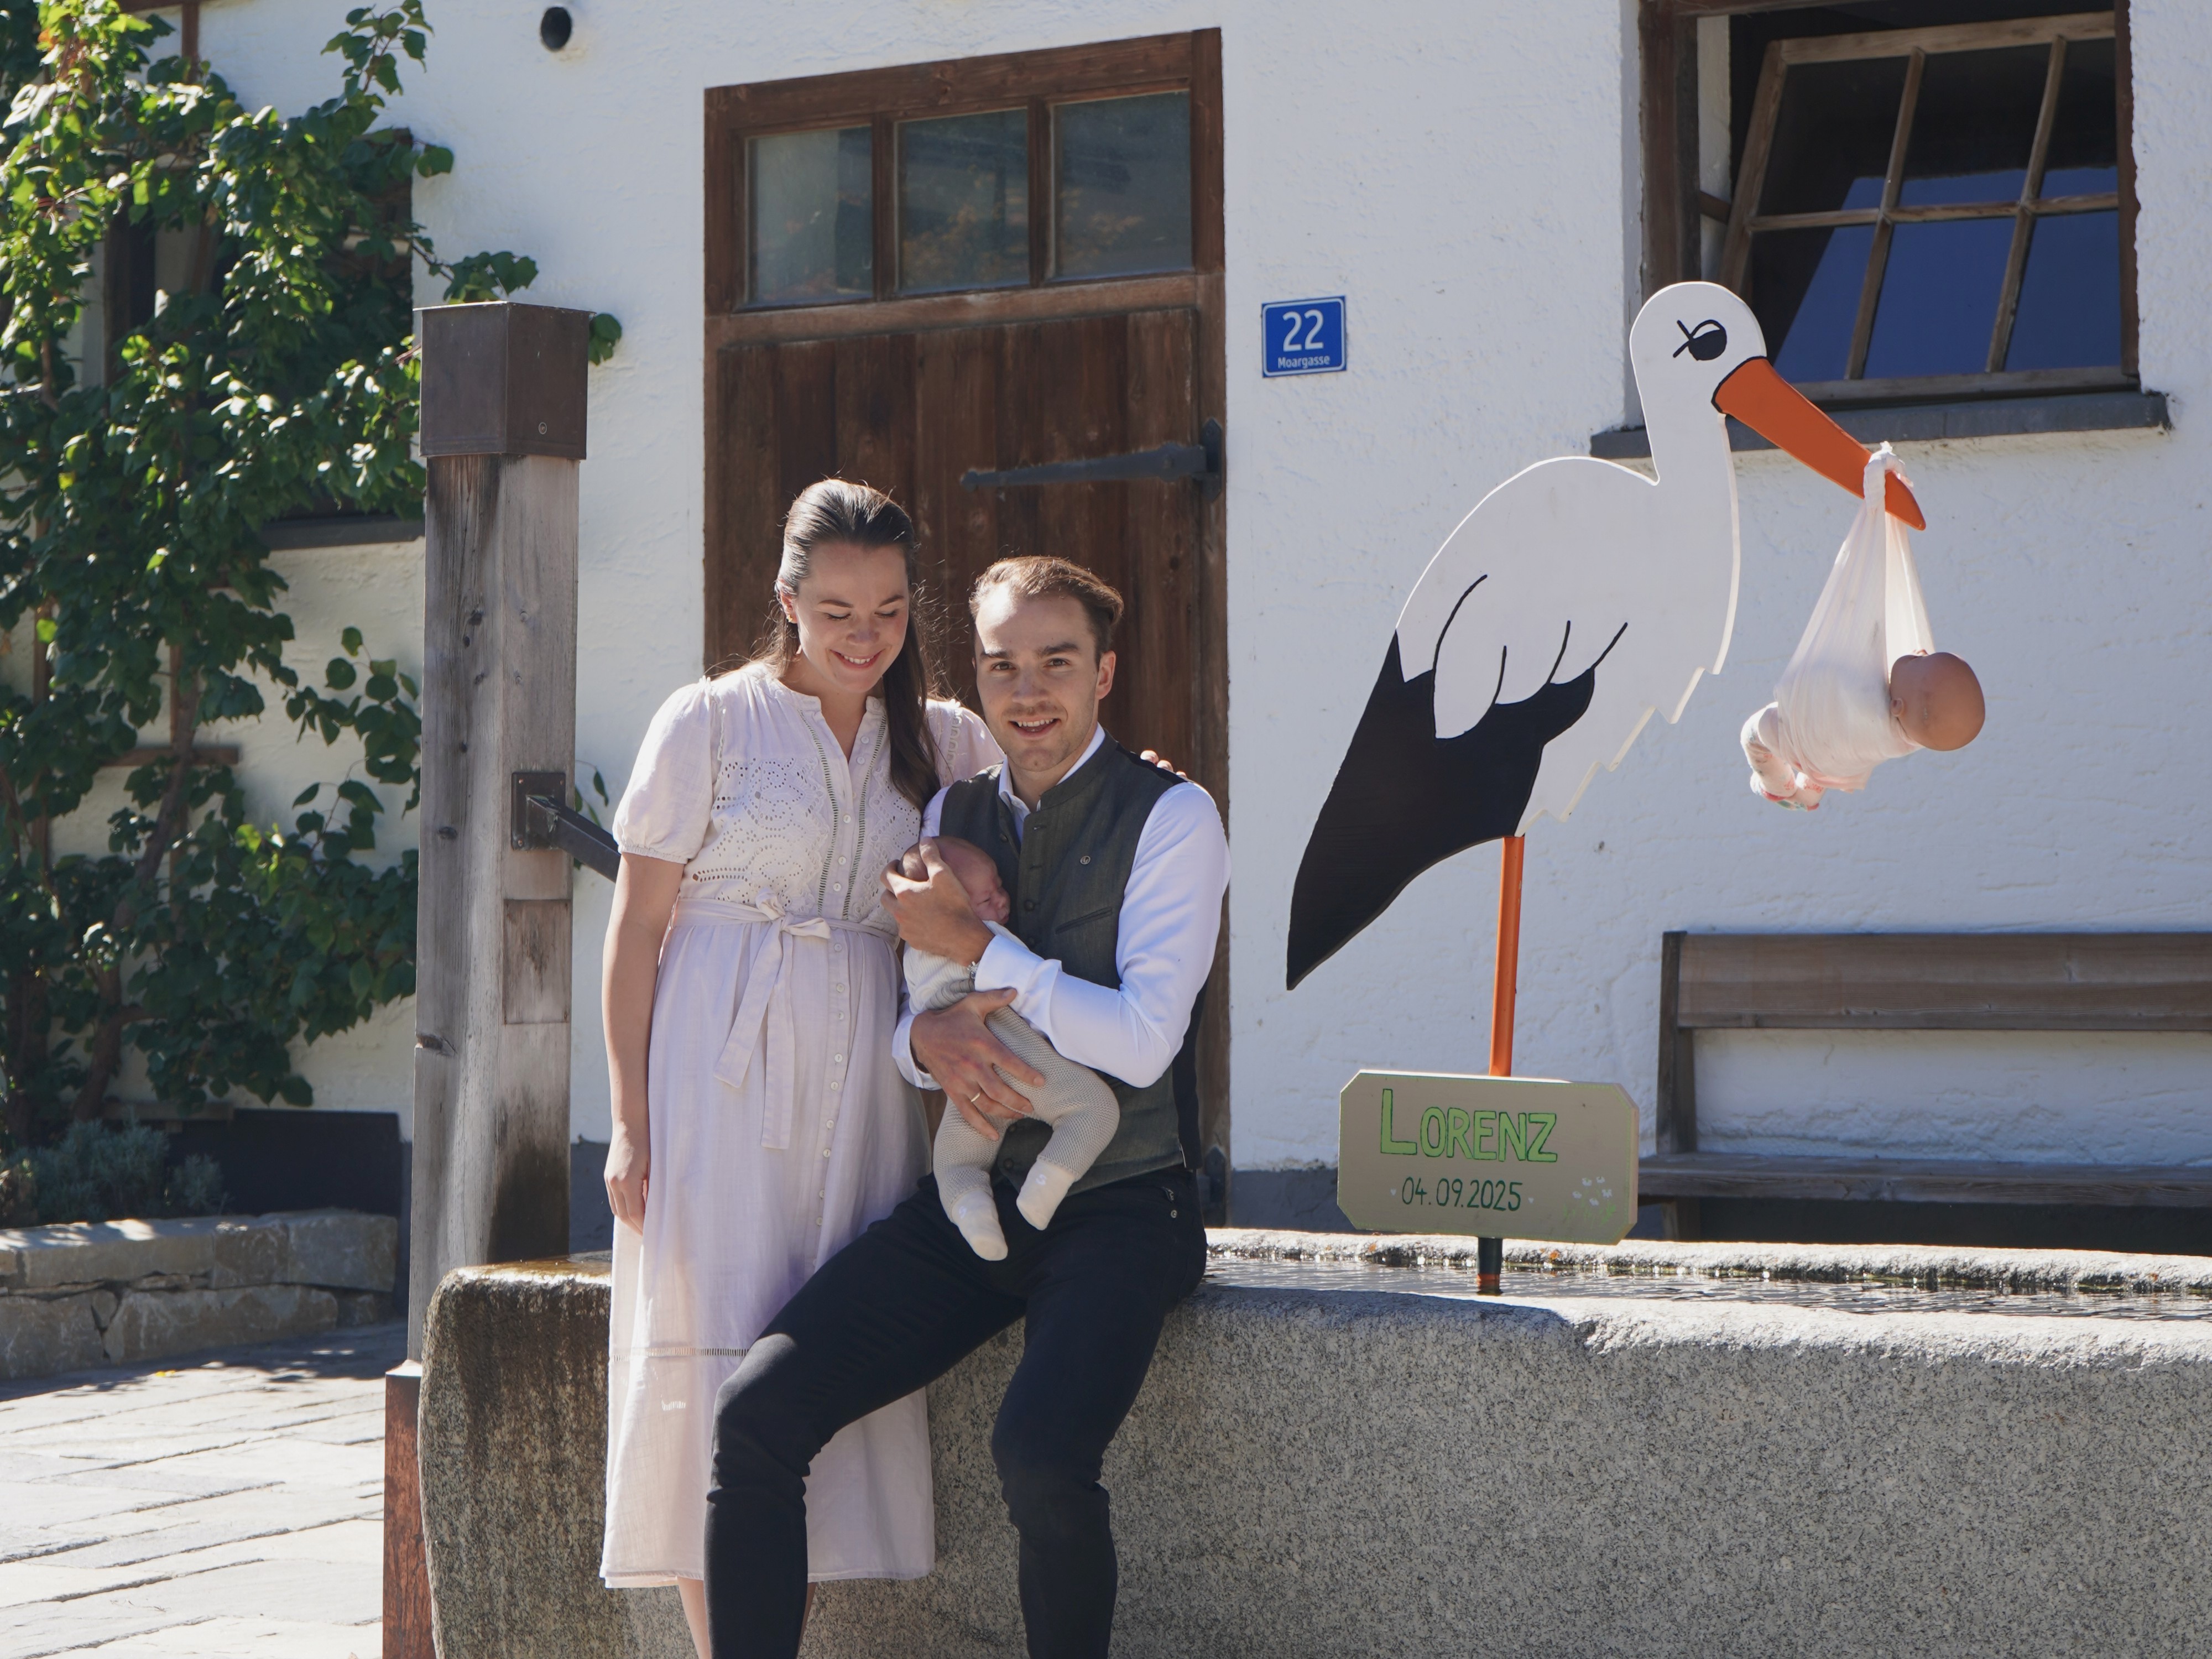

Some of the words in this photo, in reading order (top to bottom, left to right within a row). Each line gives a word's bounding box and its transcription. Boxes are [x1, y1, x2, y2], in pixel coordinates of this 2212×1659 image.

[1282, 310, 1324, 352] 22
[1278, 356, 1331, 369] Moargasse
[1380, 1088, 1558, 1162] LORENZ
[1402, 1176, 1523, 1211] 04.09.2025
